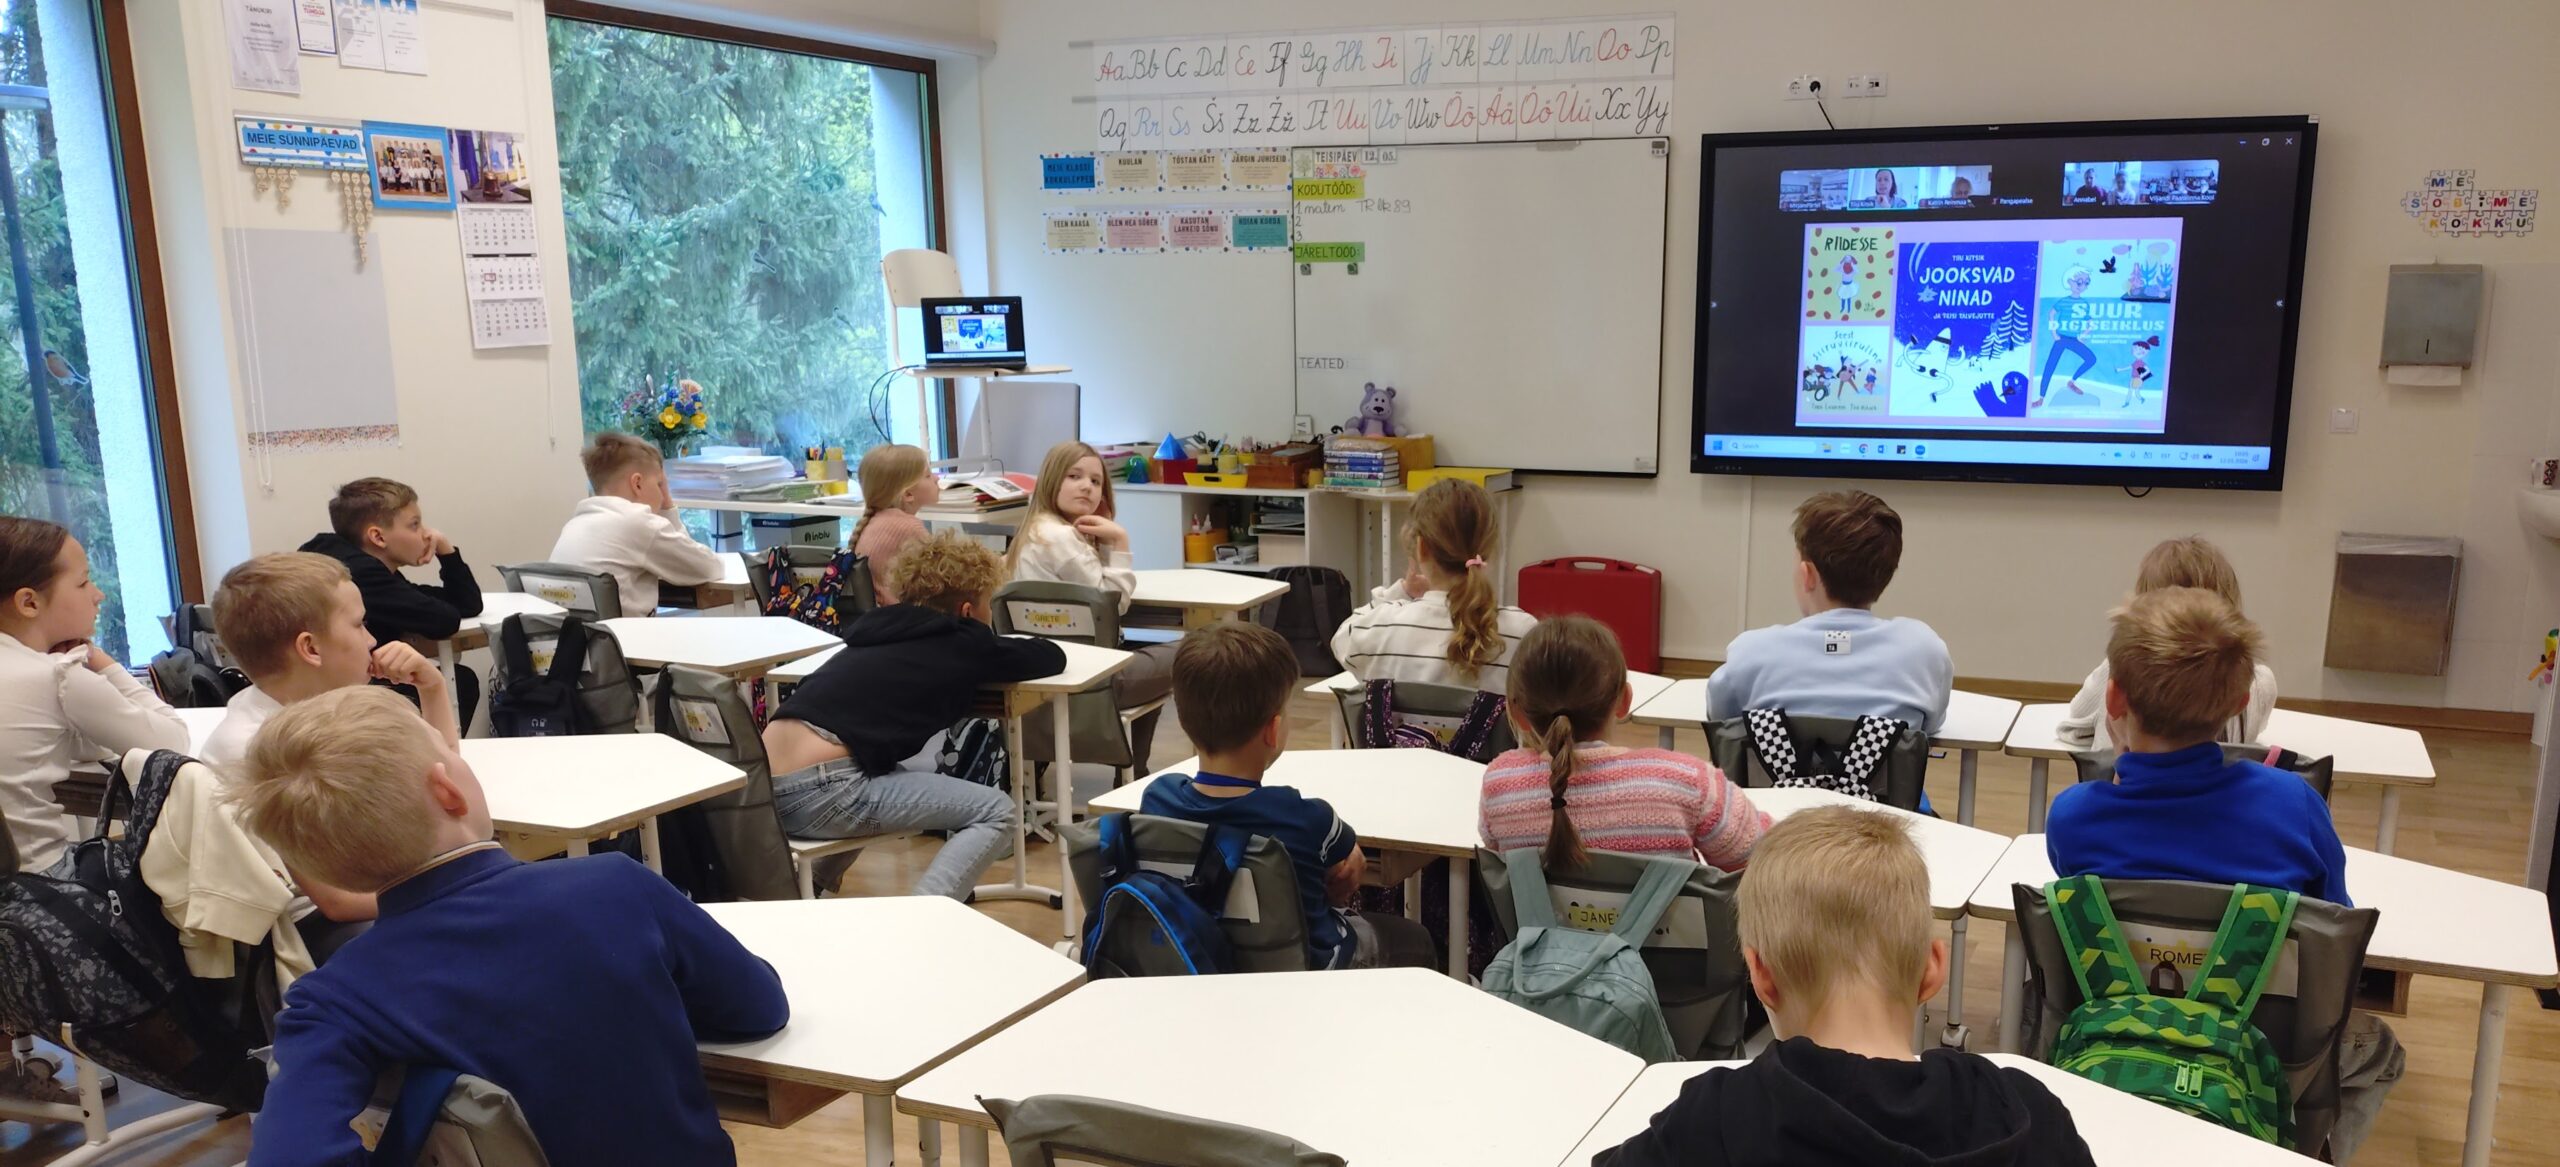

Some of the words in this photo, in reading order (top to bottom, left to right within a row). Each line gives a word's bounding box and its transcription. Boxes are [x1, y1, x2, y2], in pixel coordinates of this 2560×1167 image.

[247, 132, 276, 144] MEIE
[279, 134, 357, 150] SÜNNIPÄEVAD
[1316, 150, 1358, 162] TEISIPÄEV
[1297, 181, 1355, 195] KODUTÖÖD:
[2431, 177, 2465, 187] ME
[1304, 202, 1346, 214] matem
[1180, 217, 1209, 225] KASUTAN
[2429, 219, 2526, 228] KOKKU
[1824, 236, 1878, 251] RIIDESSE
[1919, 266, 2015, 284] JOOKSVAD
[1938, 289, 1993, 307] NINAD
[2071, 303, 2142, 319] SUUR
[2048, 320, 2165, 331] DIGISEIKLUS
[812, 531, 831, 540] inblu
[2150, 948, 2208, 965] ROME
